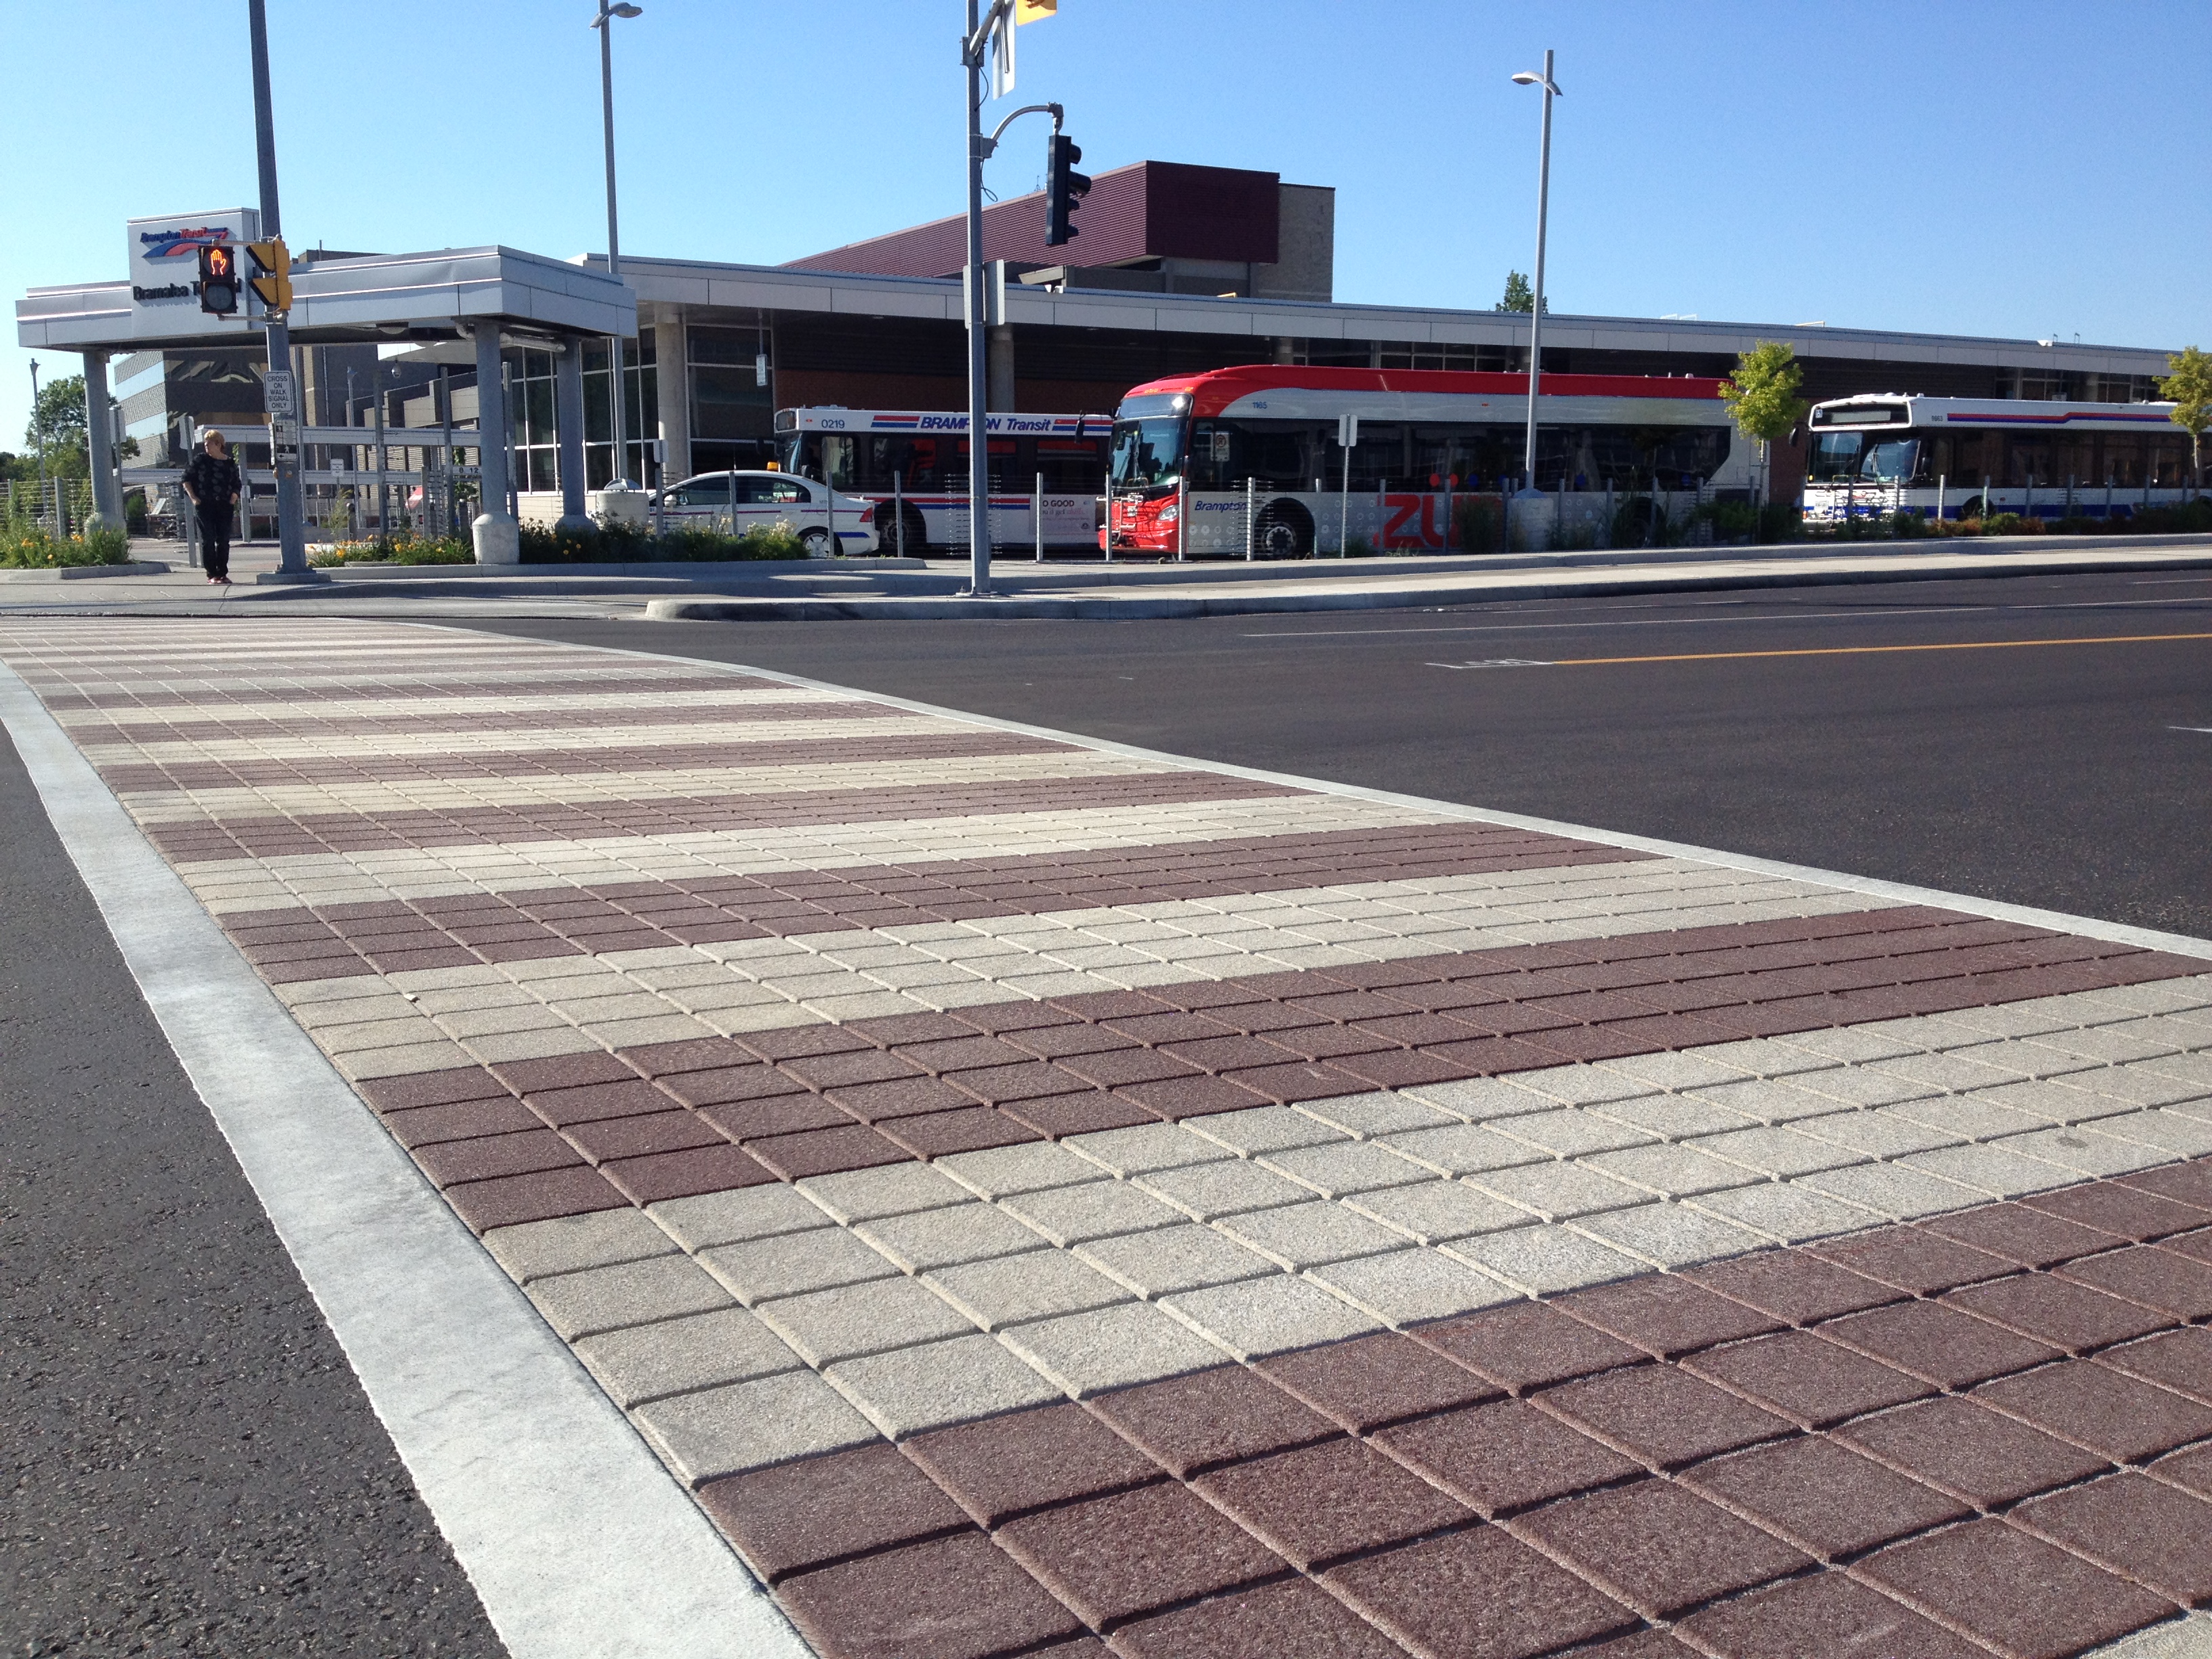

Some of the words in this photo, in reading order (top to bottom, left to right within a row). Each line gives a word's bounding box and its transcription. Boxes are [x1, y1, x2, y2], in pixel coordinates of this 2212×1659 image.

[133, 283, 189, 300] Bramalea
[821, 419, 845, 429] 0219
[920, 417, 1001, 430] BRAMPON
[1007, 418, 1050, 431] Transit
[1194, 500, 1248, 513] Brampton
